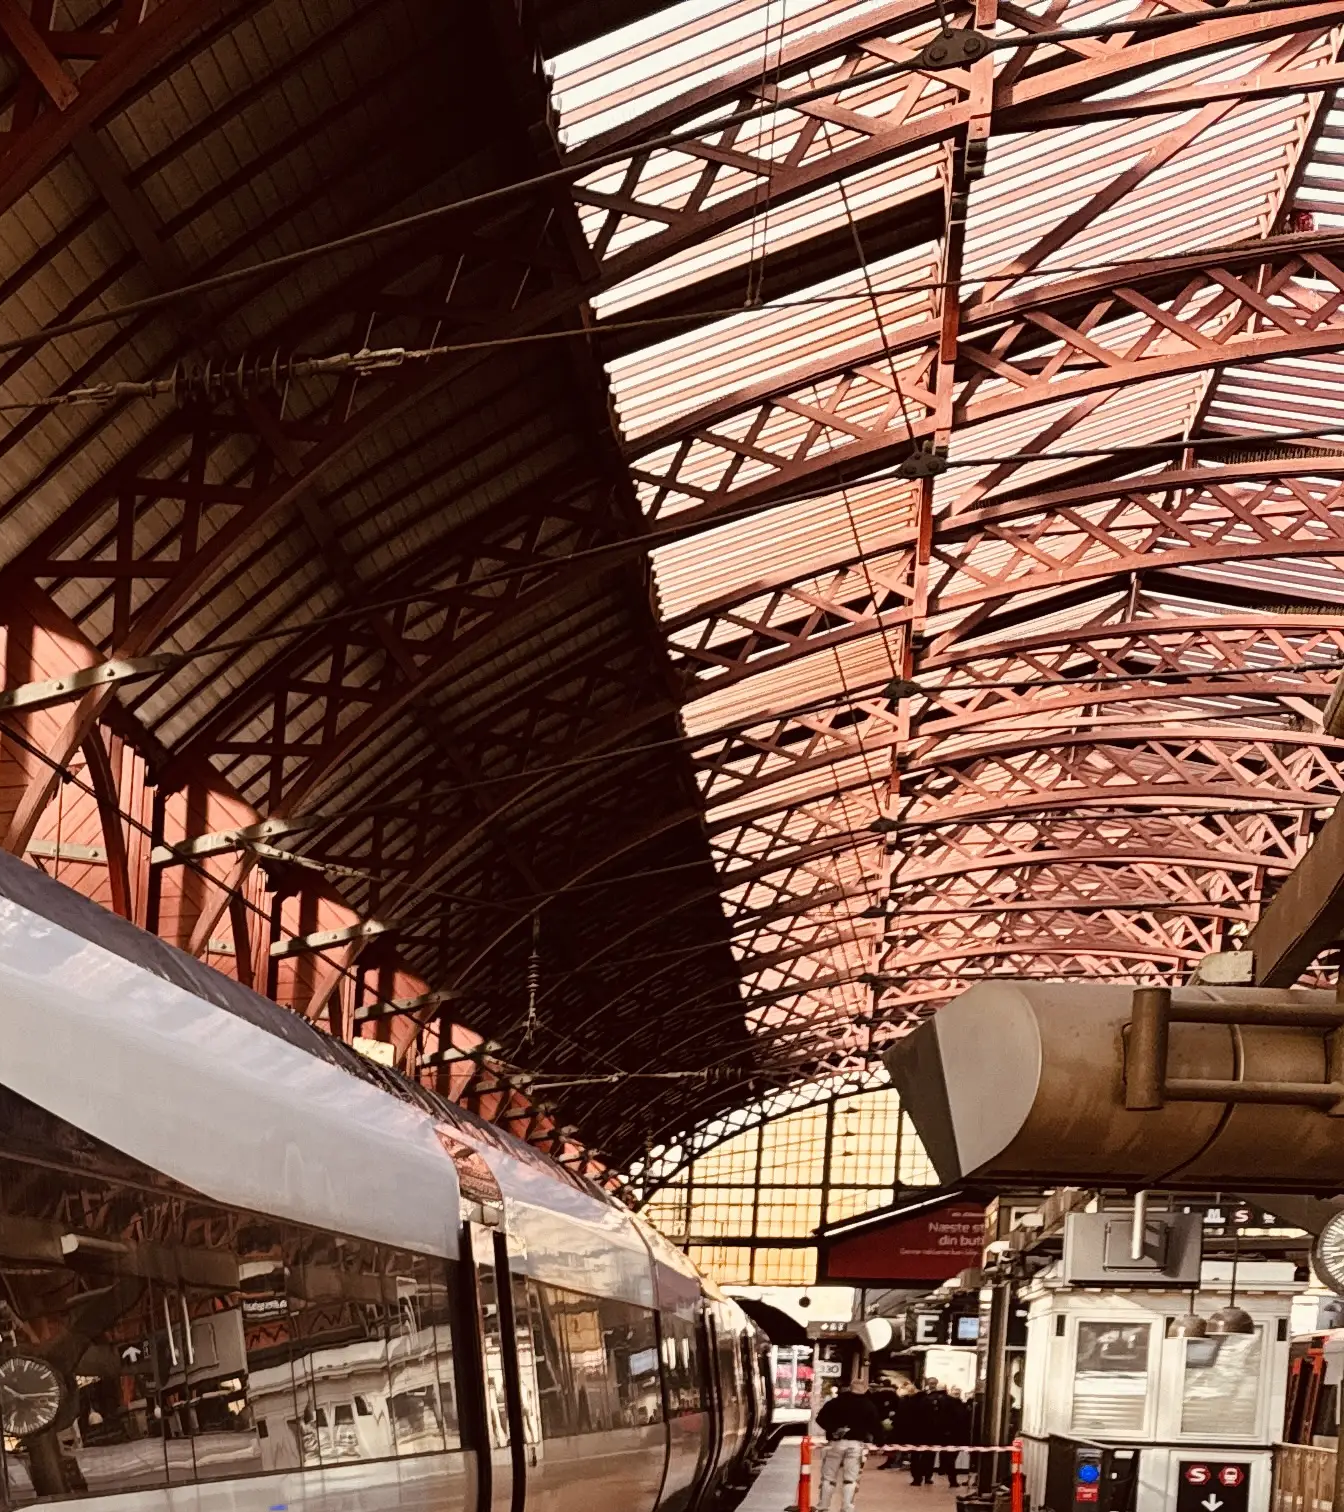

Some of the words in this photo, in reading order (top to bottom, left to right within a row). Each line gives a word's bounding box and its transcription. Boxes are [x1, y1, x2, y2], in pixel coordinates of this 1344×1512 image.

[1234, 1209, 1249, 1223] S
[928, 1222, 971, 1233] Næste
[939, 1235, 958, 1246] din
[916, 1314, 940, 1343] E
[1190, 1467, 1206, 1483] S
